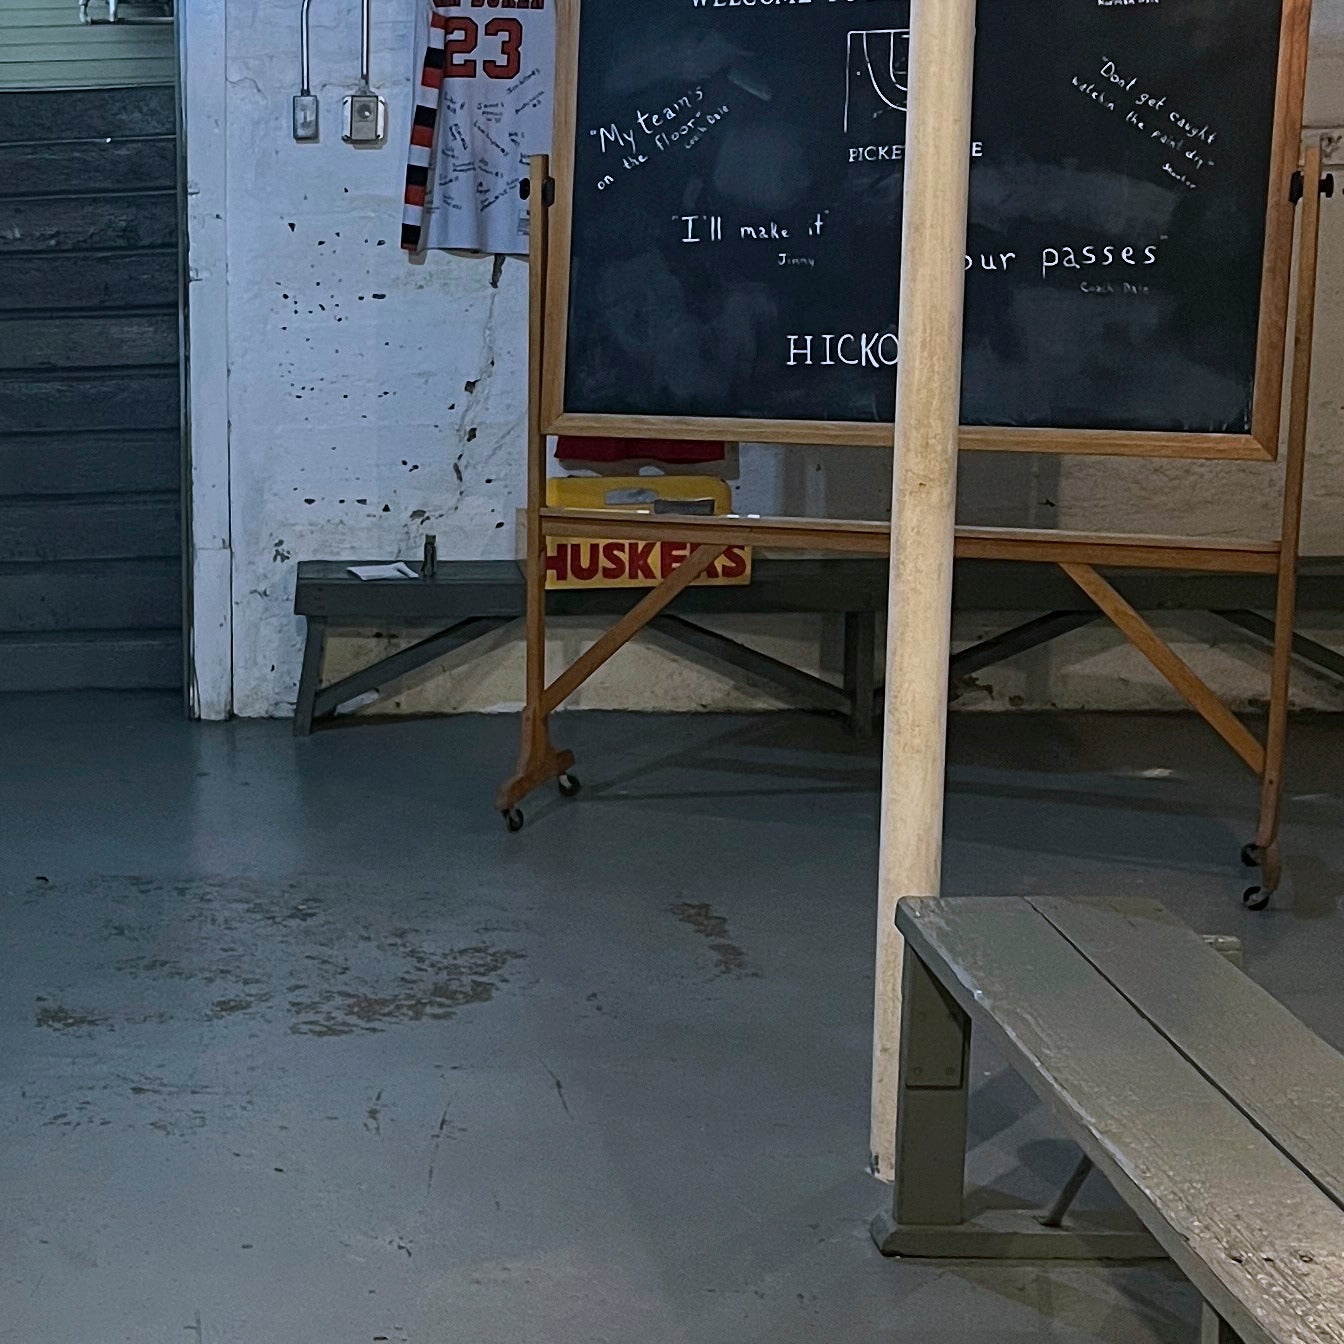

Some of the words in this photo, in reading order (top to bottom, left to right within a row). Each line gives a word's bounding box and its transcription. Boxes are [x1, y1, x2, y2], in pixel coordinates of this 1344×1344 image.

[443, 15, 523, 80] 23
[1125, 110, 1144, 130] the
[1135, 93, 1167, 110] get
[1169, 111, 1216, 144] caught
[847, 144, 906, 163] PICKE
[597, 174, 615, 190] on
[621, 155, 649, 170] the
[739, 221, 791, 239] make
[963, 252, 1016, 271] our
[785, 332, 900, 368] HICKO
